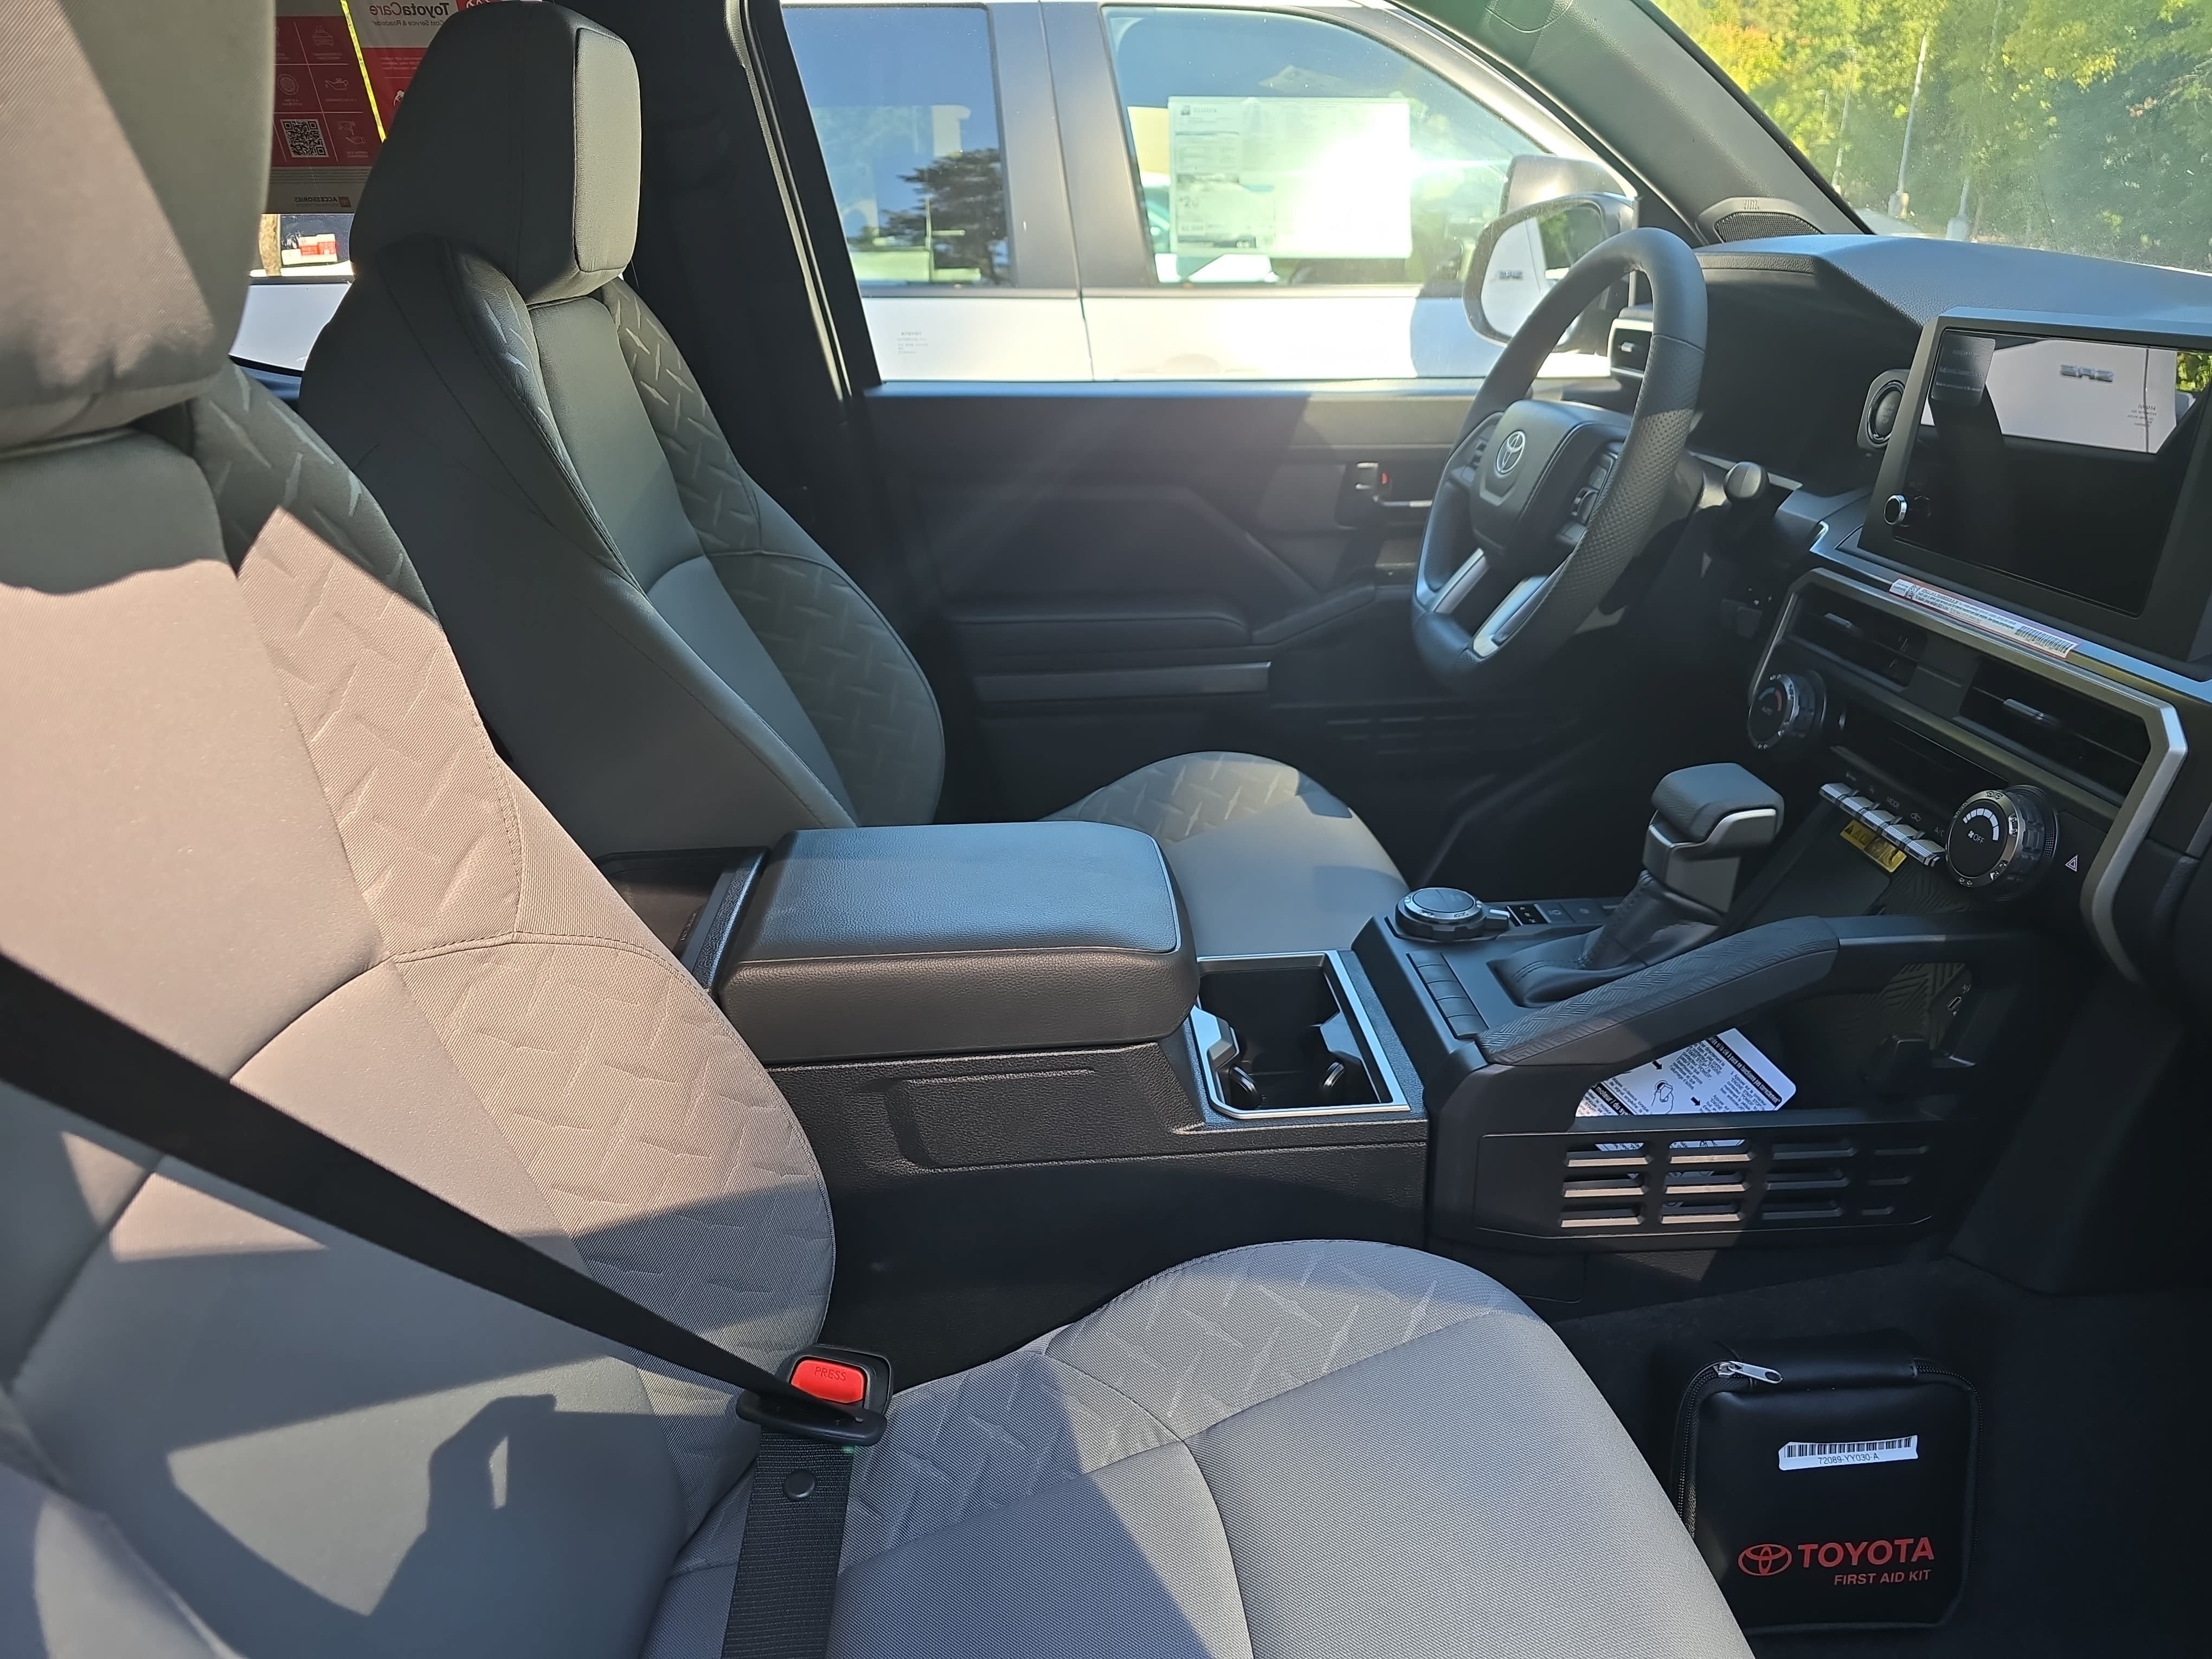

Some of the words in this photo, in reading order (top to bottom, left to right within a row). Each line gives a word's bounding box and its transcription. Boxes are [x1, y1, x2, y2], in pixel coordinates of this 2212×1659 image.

[1934, 827, 1945, 837] A/C
[1973, 833, 1985, 844] OFF
[1594, 1085, 1613, 1103] moteur
[1612, 1101, 1623, 1110] du
[815, 1366, 846, 1381] PRESS
[1818, 1452, 1880, 1465] 72089-YY030-A
[1797, 1536, 1935, 1568] TOYOTA
[1834, 1573, 1876, 1586] FIRST
[1880, 1571, 1905, 1584] AID
[1908, 1570, 1932, 1582] KIT
